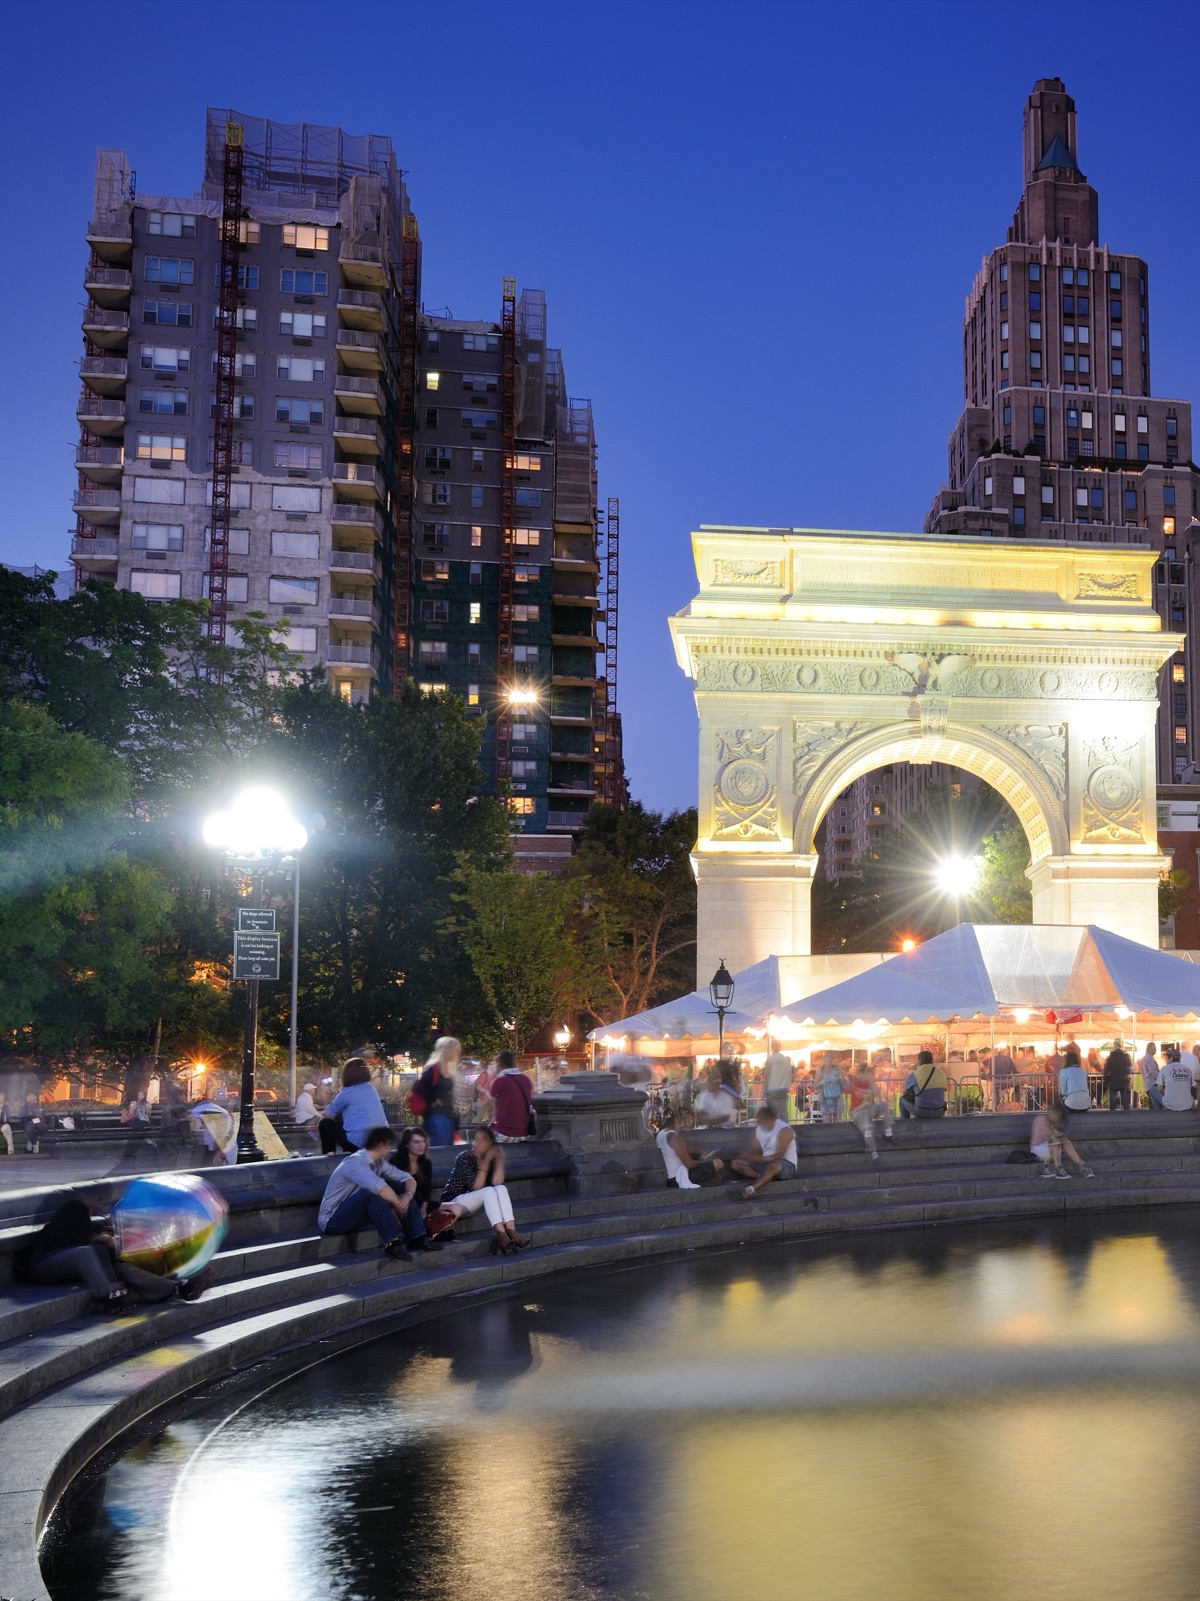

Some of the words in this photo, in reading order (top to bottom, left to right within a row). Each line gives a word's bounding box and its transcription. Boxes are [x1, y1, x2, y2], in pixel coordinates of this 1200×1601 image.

[949, 567, 964, 576] TO
[966, 568, 1001, 578] WHICH
[1003, 569, 1024, 579] THE
[1028, 570, 1052, 580] WISE
[936, 576, 974, 585] REPAIR
[1016, 579, 1051, 589] EVENT
